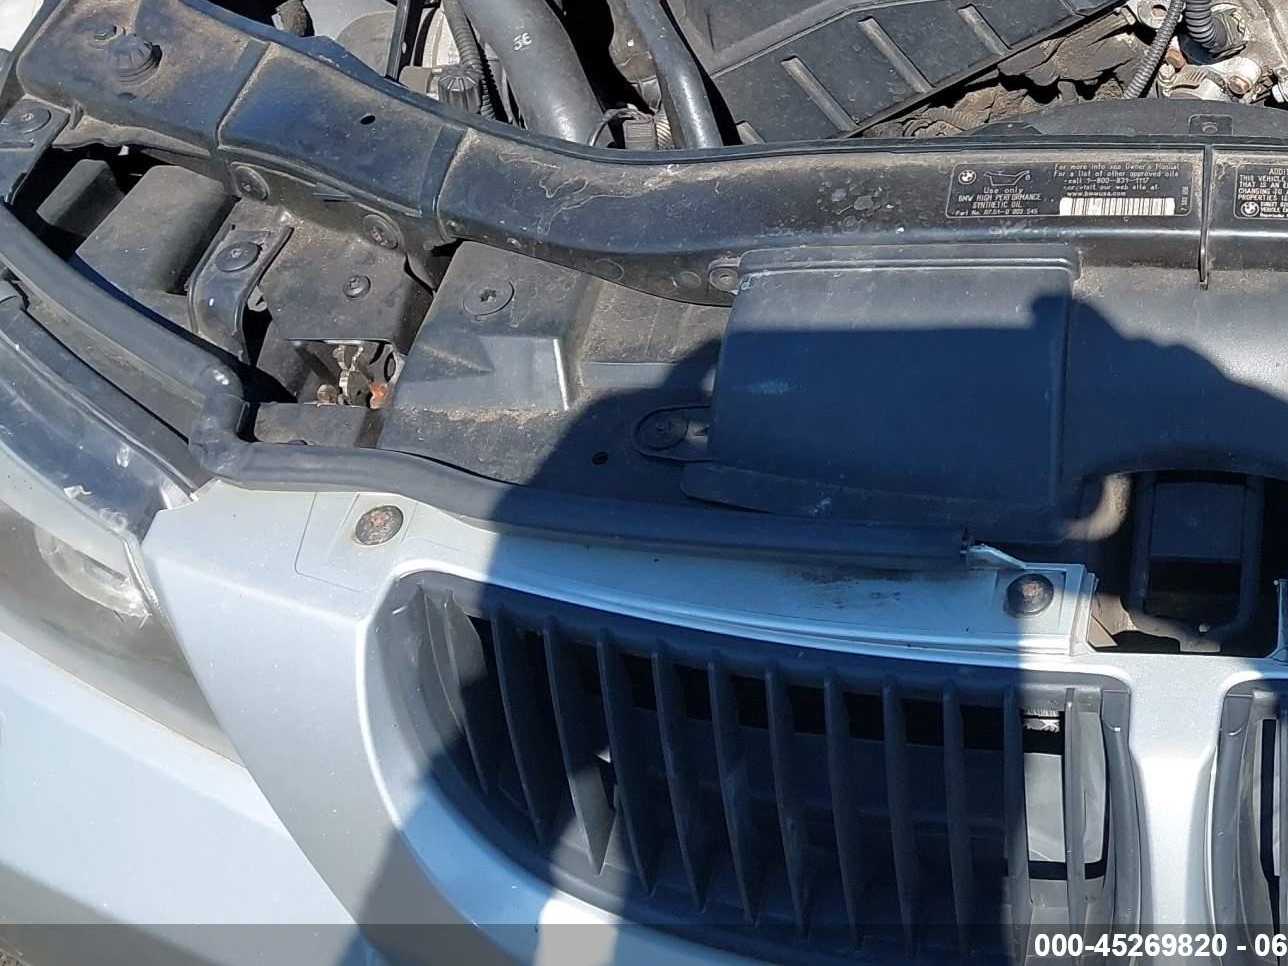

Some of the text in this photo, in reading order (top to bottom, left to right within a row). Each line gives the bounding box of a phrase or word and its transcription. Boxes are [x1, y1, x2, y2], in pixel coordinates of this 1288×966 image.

[1129, 170, 1161, 178] approved
[1240, 174, 1255, 182] THIS
[983, 186, 1024, 195] Use only
[1132, 183, 1147, 191] site
[958, 193, 1041, 202] BMW HIGH PERFORMANCE
[972, 201, 1008, 209] SYNTHETIC
